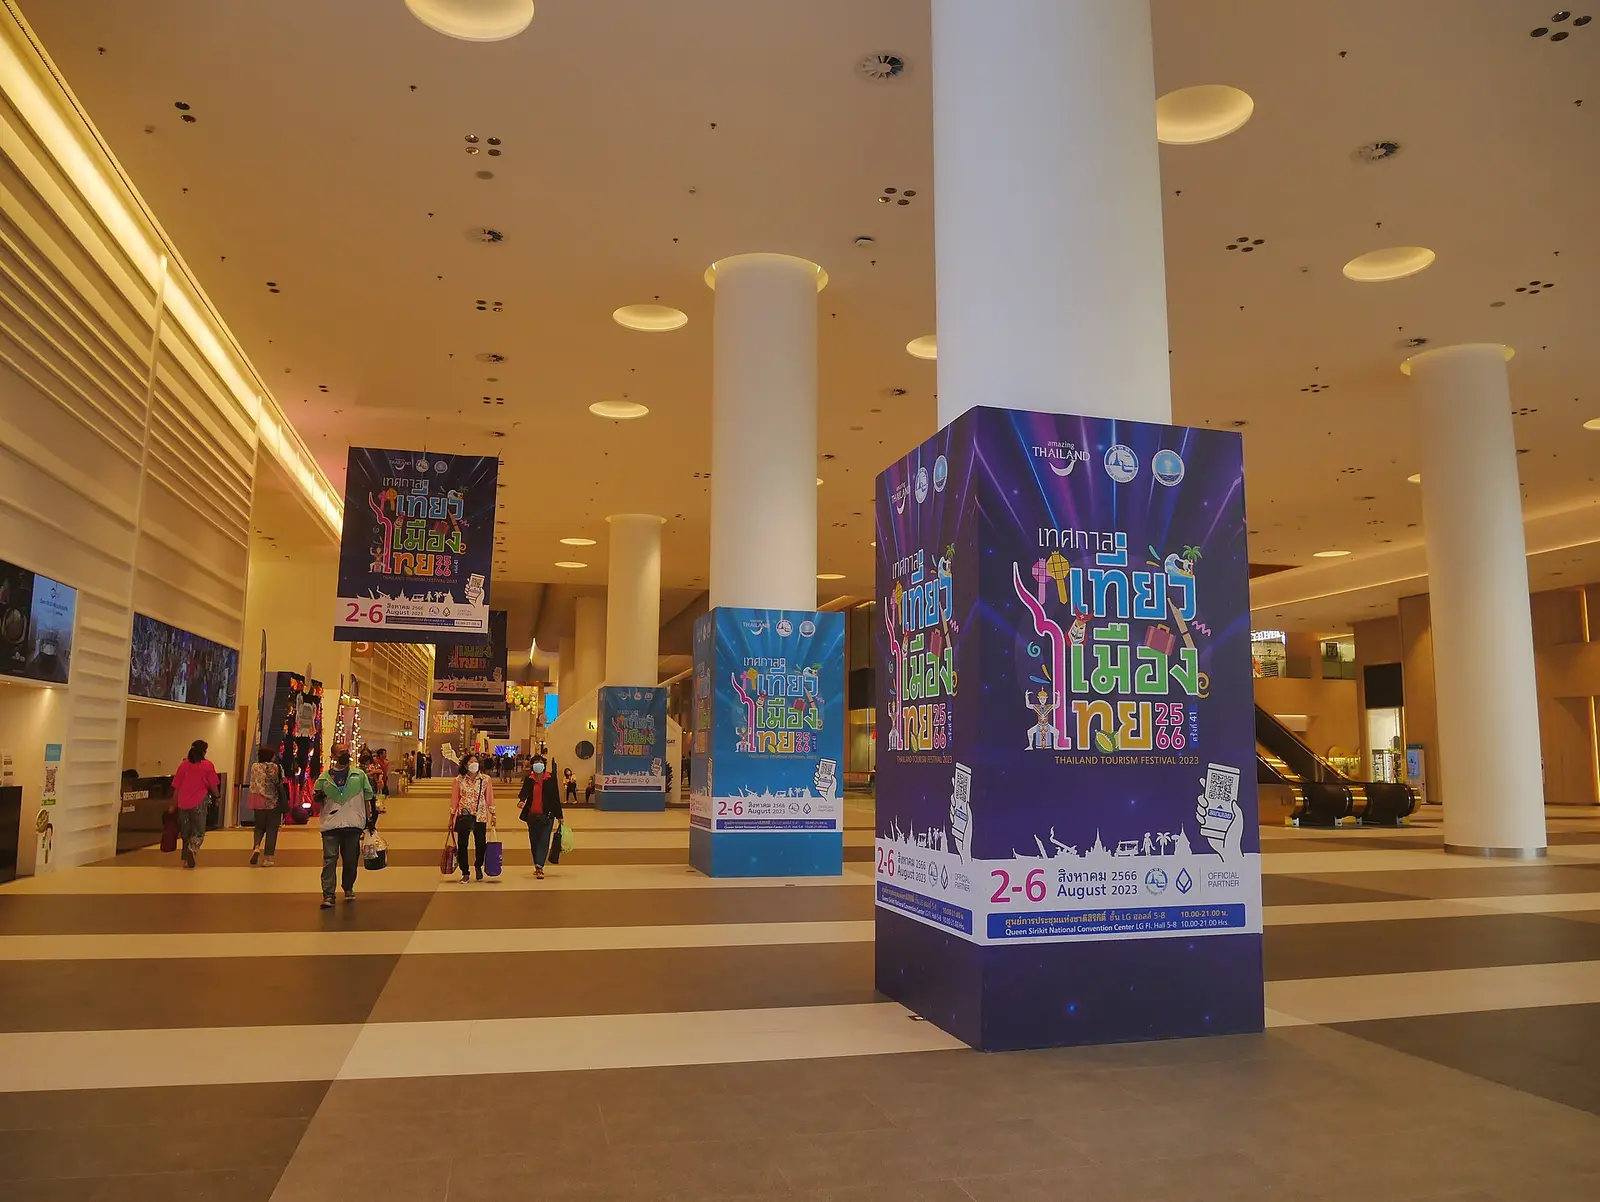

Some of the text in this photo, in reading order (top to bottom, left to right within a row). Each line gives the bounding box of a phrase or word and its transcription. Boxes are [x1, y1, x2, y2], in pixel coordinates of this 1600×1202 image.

[1047, 440, 1075, 450] amazing
[1032, 446, 1090, 461] THAILAND
[1038, 527, 1114, 550] เทศกาล
[345, 602, 384, 624] 2-6
[1070, 622, 1199, 695] เมือง
[902, 632, 953, 701] เมือง
[437, 681, 456, 692] 2-6
[1189, 711, 1198, 723] 41
[942, 755, 953, 764] 2023
[1055, 756, 1199, 765] THAILAND TOURISM FESTIVAL 2023
[604, 777, 618, 785] 2-6
[717, 801, 744, 816] 2-6
[877, 846, 895, 877] 2-6
[897, 864, 926, 883] August 2023
[1057, 868, 1107, 883] สิงหาคม
[1111, 871, 1138, 882] 2566
[1207, 871, 1240, 881] OFFICIAL
[990, 868, 1047, 903] 2-6
[1207, 880, 1240, 888] PARTNER
[1057, 884, 1138, 900] August 2023
[1121, 913, 1131, 921] LG
[1154, 911, 1166, 919] 5-8
[1180, 910, 1220, 918] 10.00-21.00
[1005, 928, 1027, 936] Queen
[1028, 927, 1048, 935] Sirikit
[1049, 926, 1076, 934] National
[1077, 924, 1113, 933] Convention
[1113, 923, 1135, 931] Center
[1135, 922, 1145, 930] LG
[1153, 921, 1166, 929] Hall
[1180, 919, 1218, 928] 10.00-21.00
